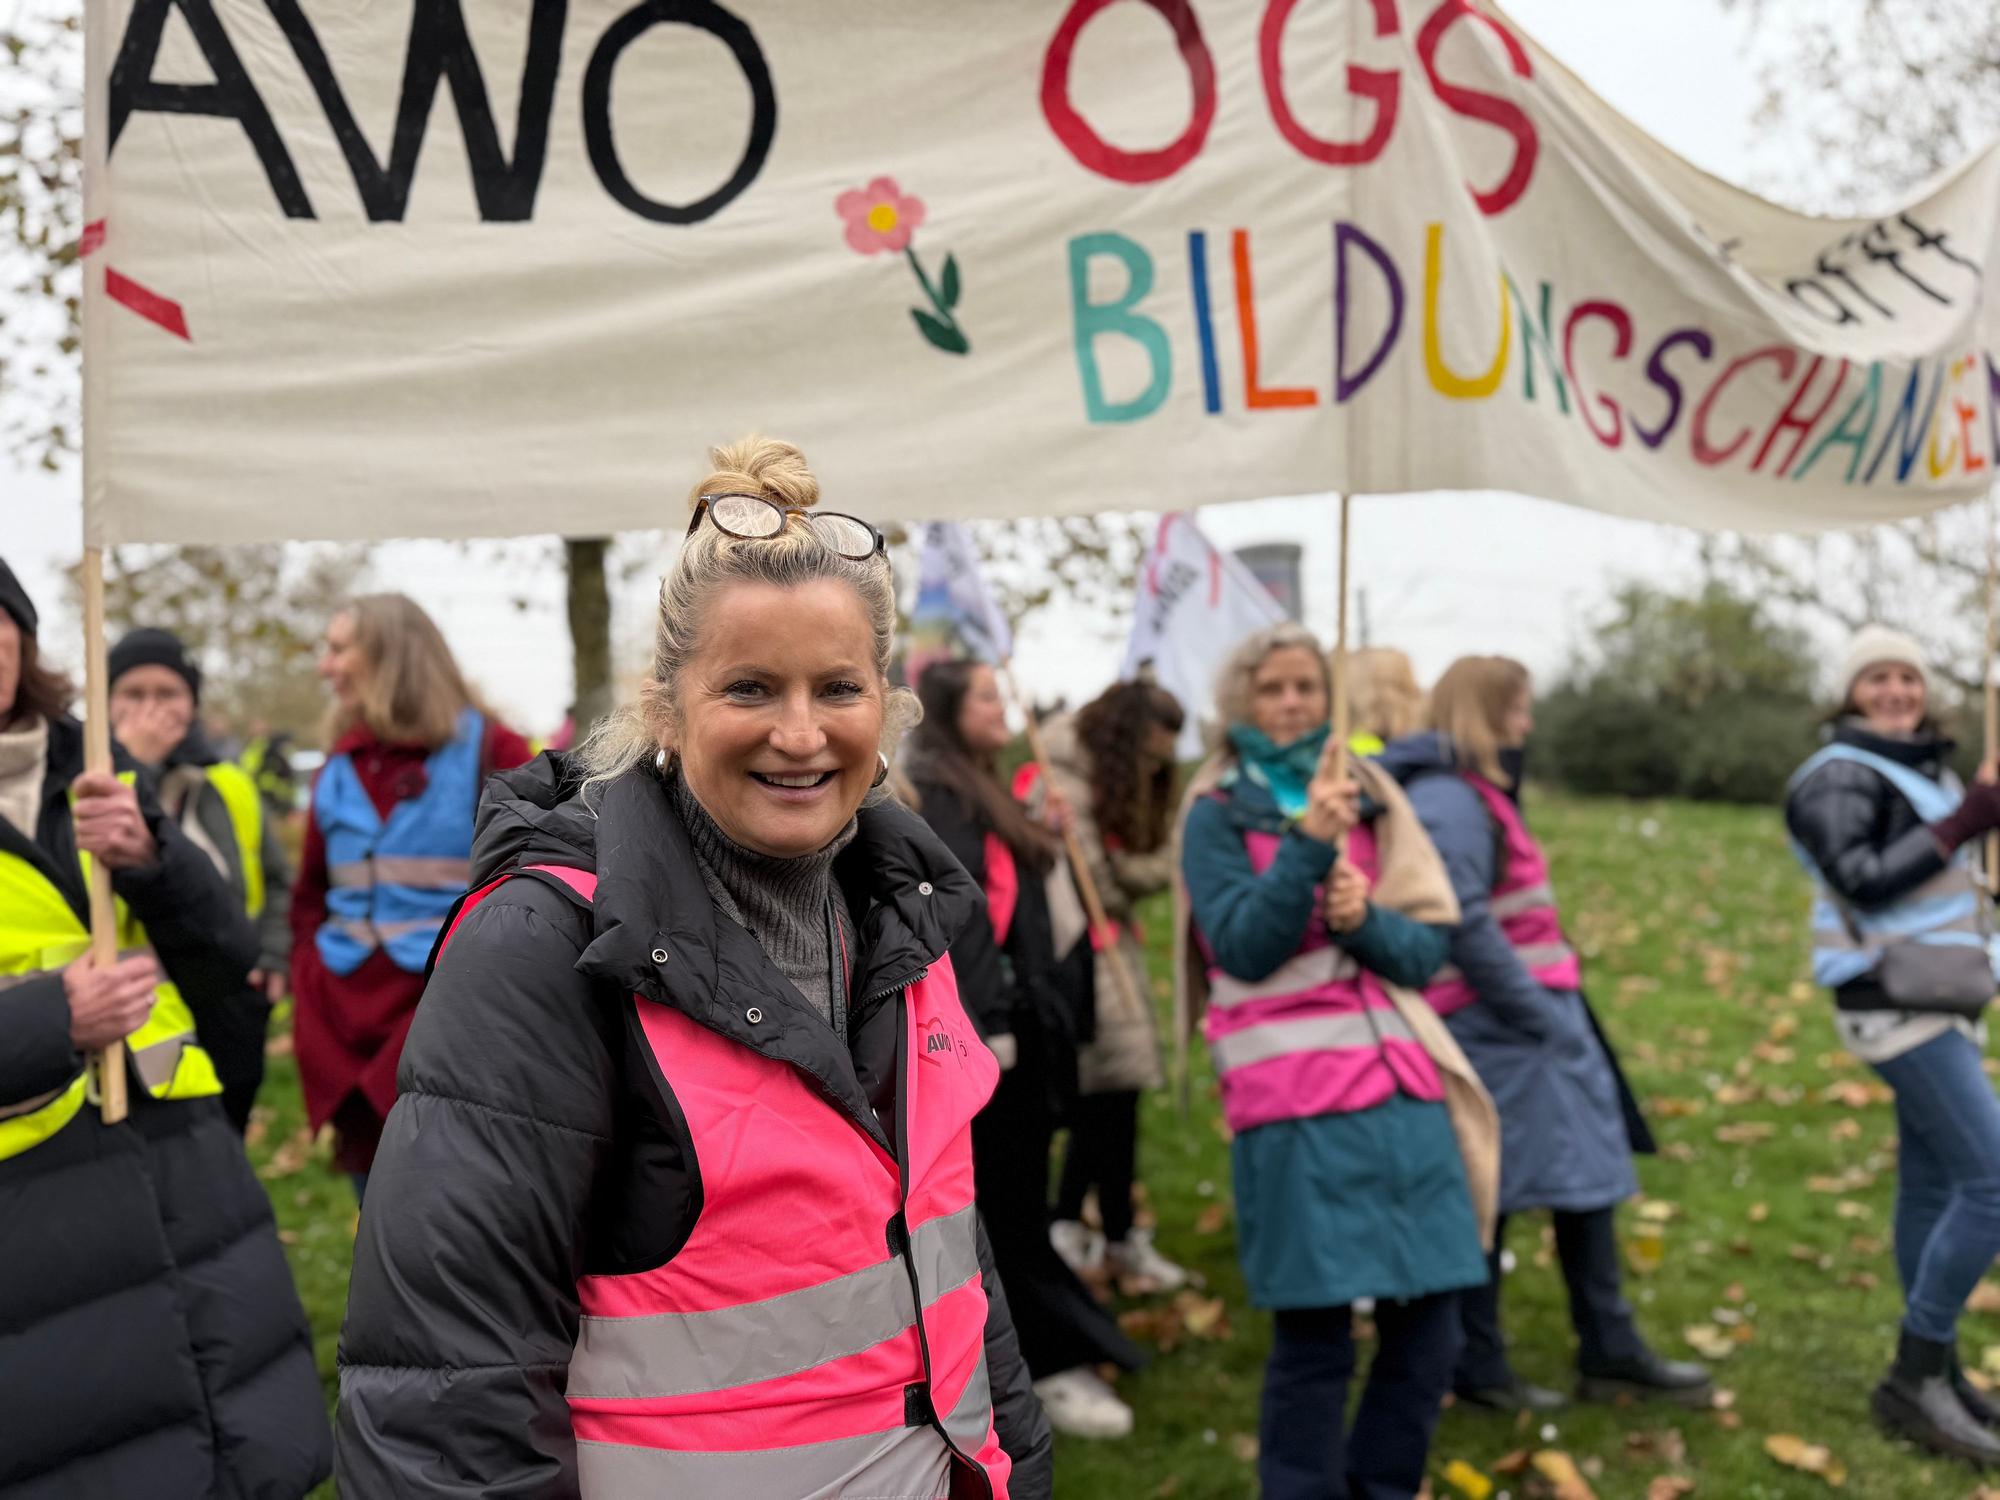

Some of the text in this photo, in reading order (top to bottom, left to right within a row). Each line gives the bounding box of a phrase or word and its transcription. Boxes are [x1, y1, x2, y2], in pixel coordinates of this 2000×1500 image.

[107, 0, 777, 226] AWO
[1038, 0, 1540, 217] OGS
[1067, 220, 2000, 486] BILDUNGSCHANCE
